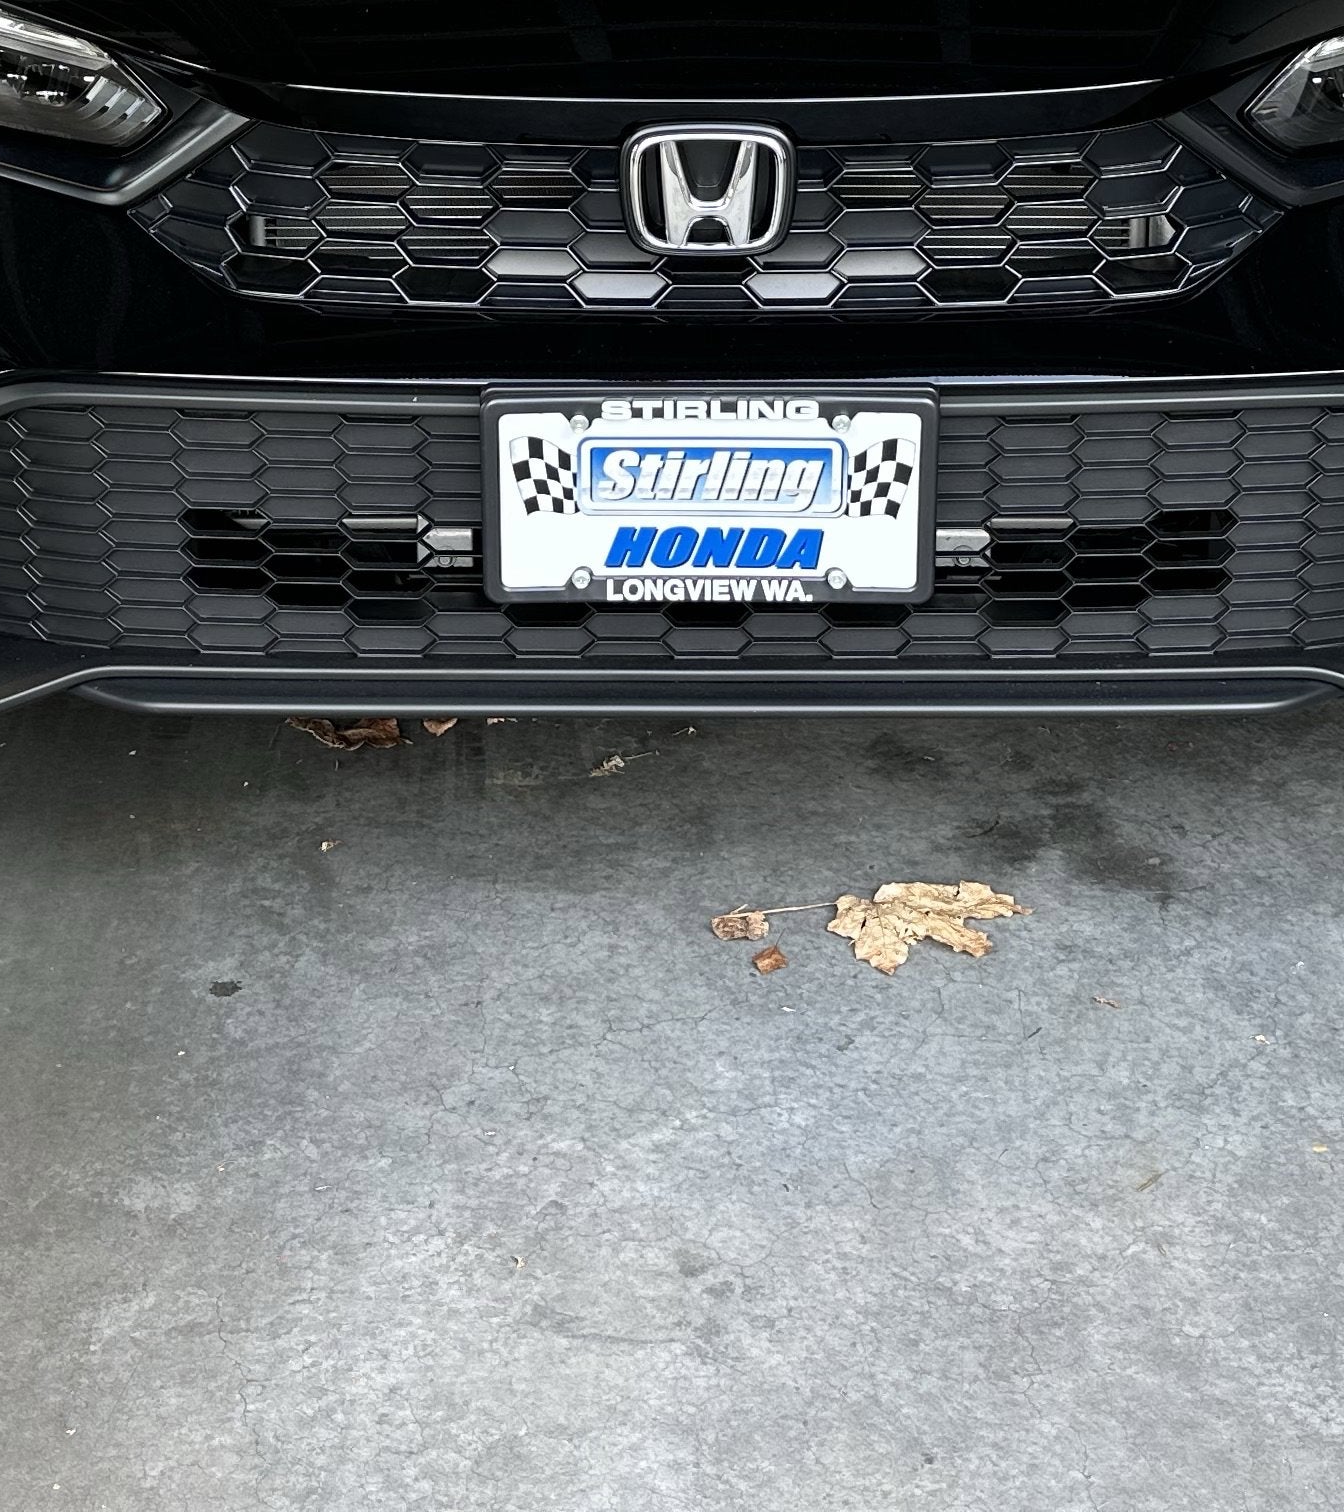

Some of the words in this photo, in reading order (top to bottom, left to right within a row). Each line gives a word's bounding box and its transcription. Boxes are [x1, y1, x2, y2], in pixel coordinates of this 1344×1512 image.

[601, 399, 820, 420] STIRLING
[598, 450, 825, 505] Stirling
[604, 526, 824, 569] HONDA
[606, 578, 756, 601] LONGVIEW
[761, 578, 813, 601] WA.
